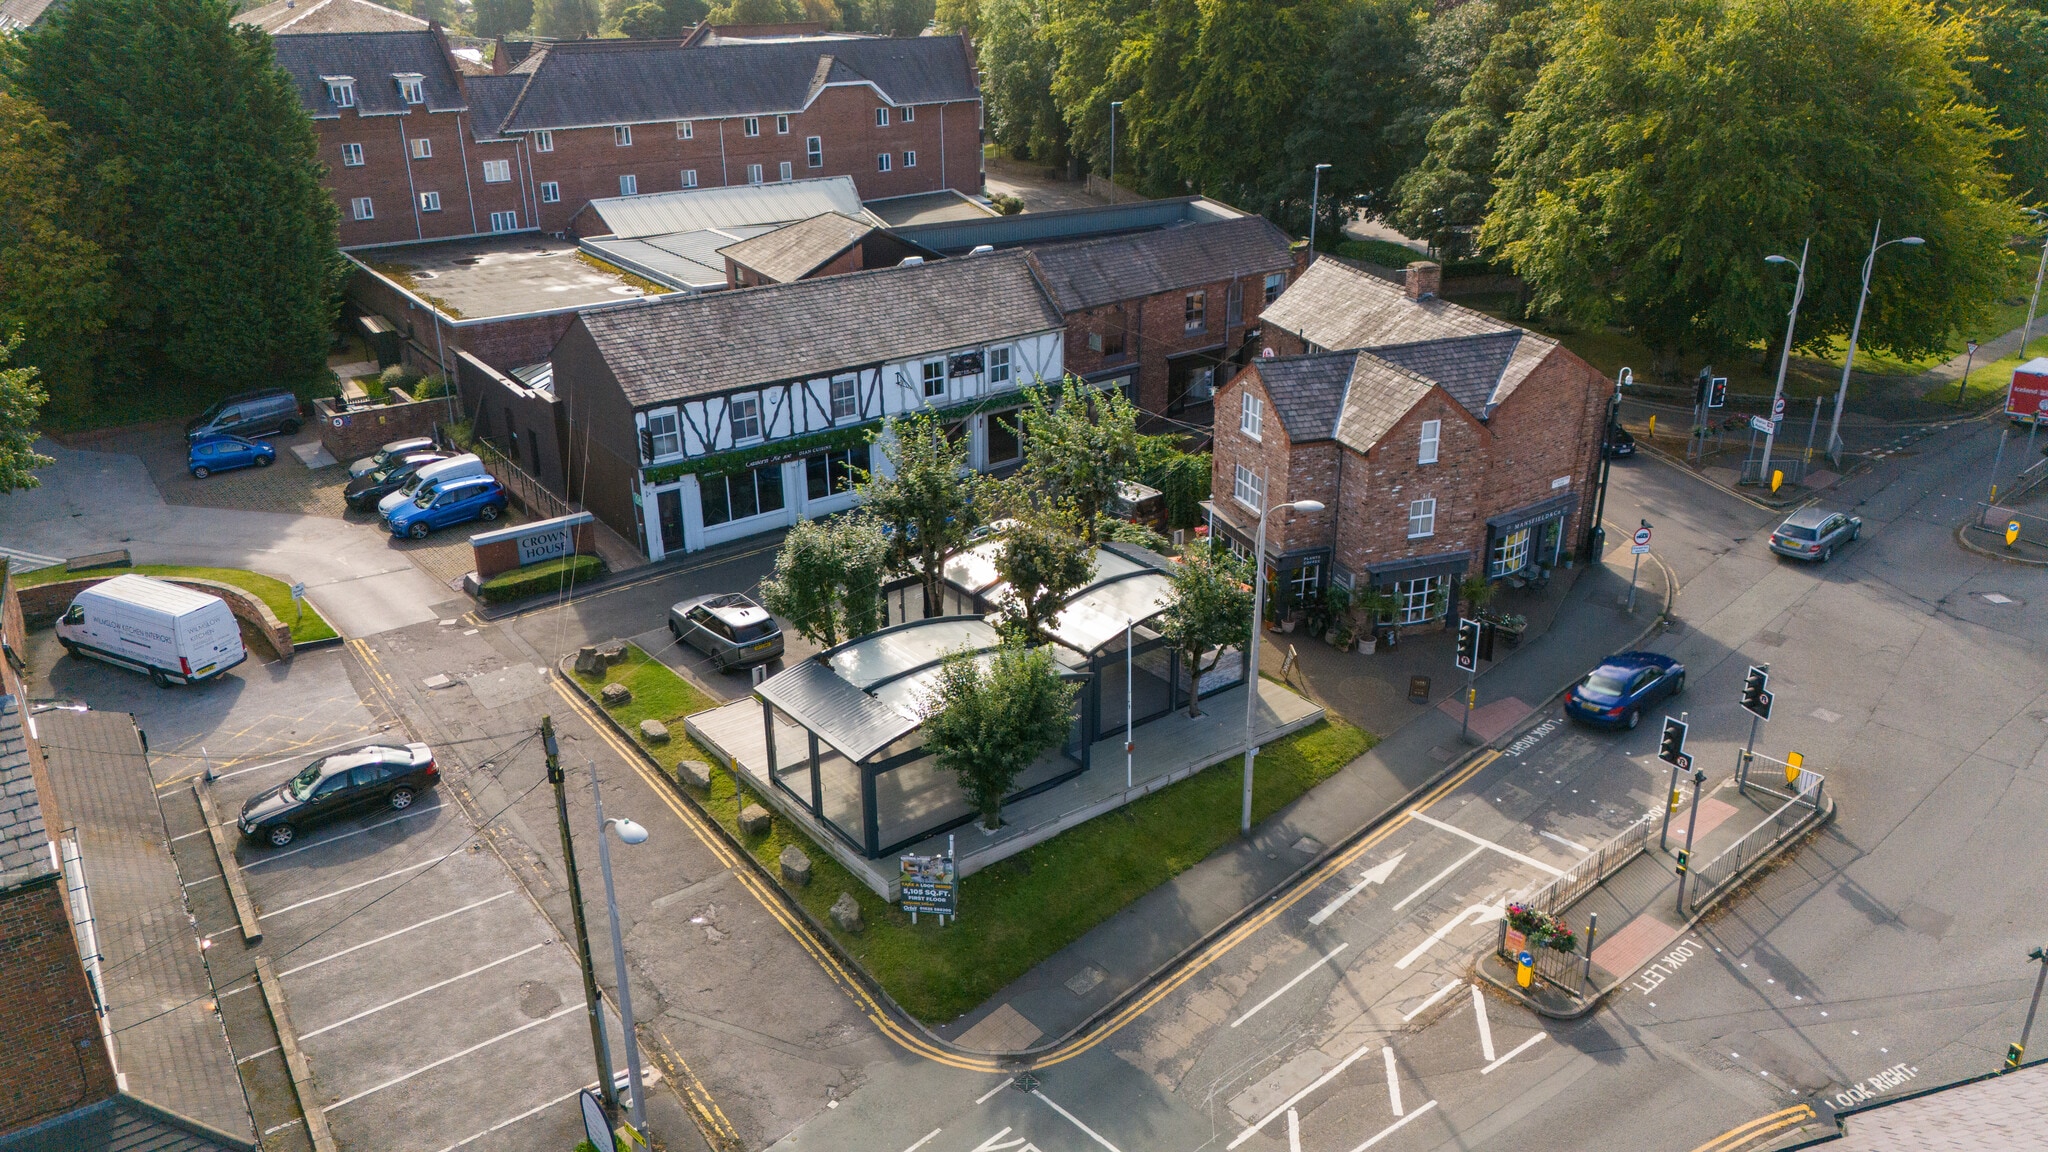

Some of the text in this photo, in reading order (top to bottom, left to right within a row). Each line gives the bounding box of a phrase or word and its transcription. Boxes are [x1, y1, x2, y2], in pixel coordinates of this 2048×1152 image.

[2014, 386, 2038, 395] Iceland
[522, 530, 568, 548] CROWN
[527, 541, 567, 558] HOUSE
[93, 617, 120, 630] WILMSLOW
[122, 625, 144, 637] KITCHEN
[145, 630, 172, 645] INTERIORS
[187, 617, 221, 634] WILMSLOW
[191, 628, 215, 641] KITCHEN
[1506, 719, 1562, 757] LOOK RIGHT
[924, 889, 951, 897] SQ.FT.
[1632, 939, 1703, 995] LOOK LEFT
[1824, 1062, 1916, 1110] LOOK RIGHT
